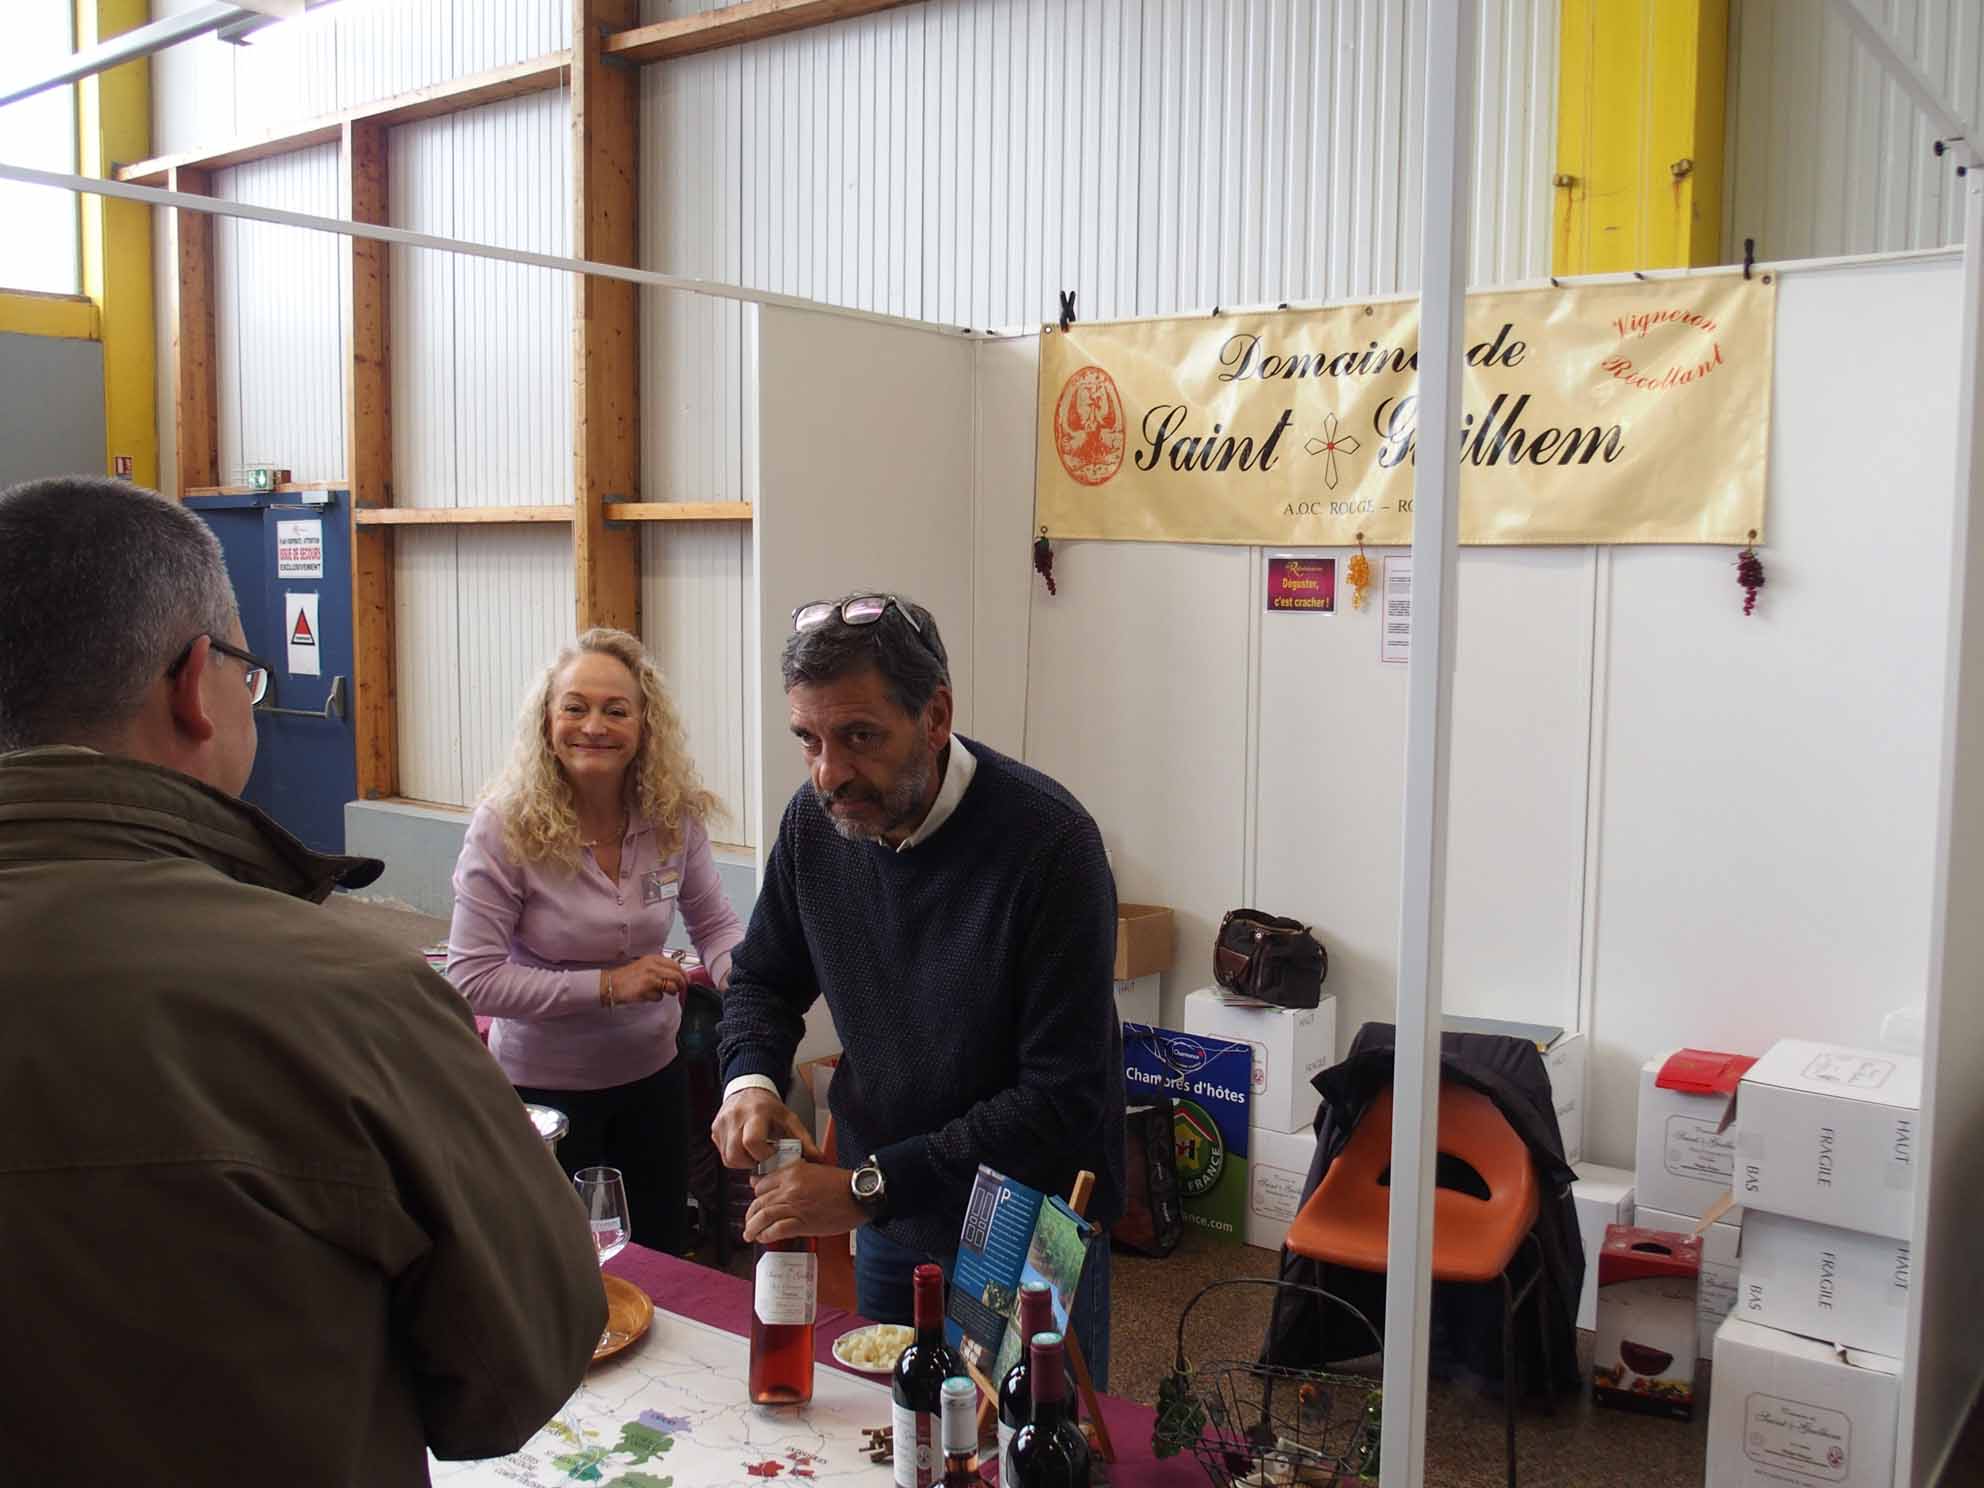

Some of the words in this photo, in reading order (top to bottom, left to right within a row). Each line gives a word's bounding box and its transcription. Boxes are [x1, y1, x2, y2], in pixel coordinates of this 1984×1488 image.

[1464, 323, 1527, 367] de
[1613, 309, 1717, 337] Vigneron
[1134, 404, 1294, 472] Saint
[1373, 393, 1625, 468] Gilhem
[1194, 1081, 1245, 1104] d'hôtes
[1817, 1127, 1834, 1187] FRAGILE
[1896, 1120, 1911, 1164] HAUT
[1187, 1147, 1221, 1192] FRANCE
[1745, 1165, 1760, 1192] BAS
[1817, 1251, 1836, 1311] FRAGILE
[1895, 1248, 1910, 1290] HAUT
[1748, 1284, 1763, 1311] BAS
